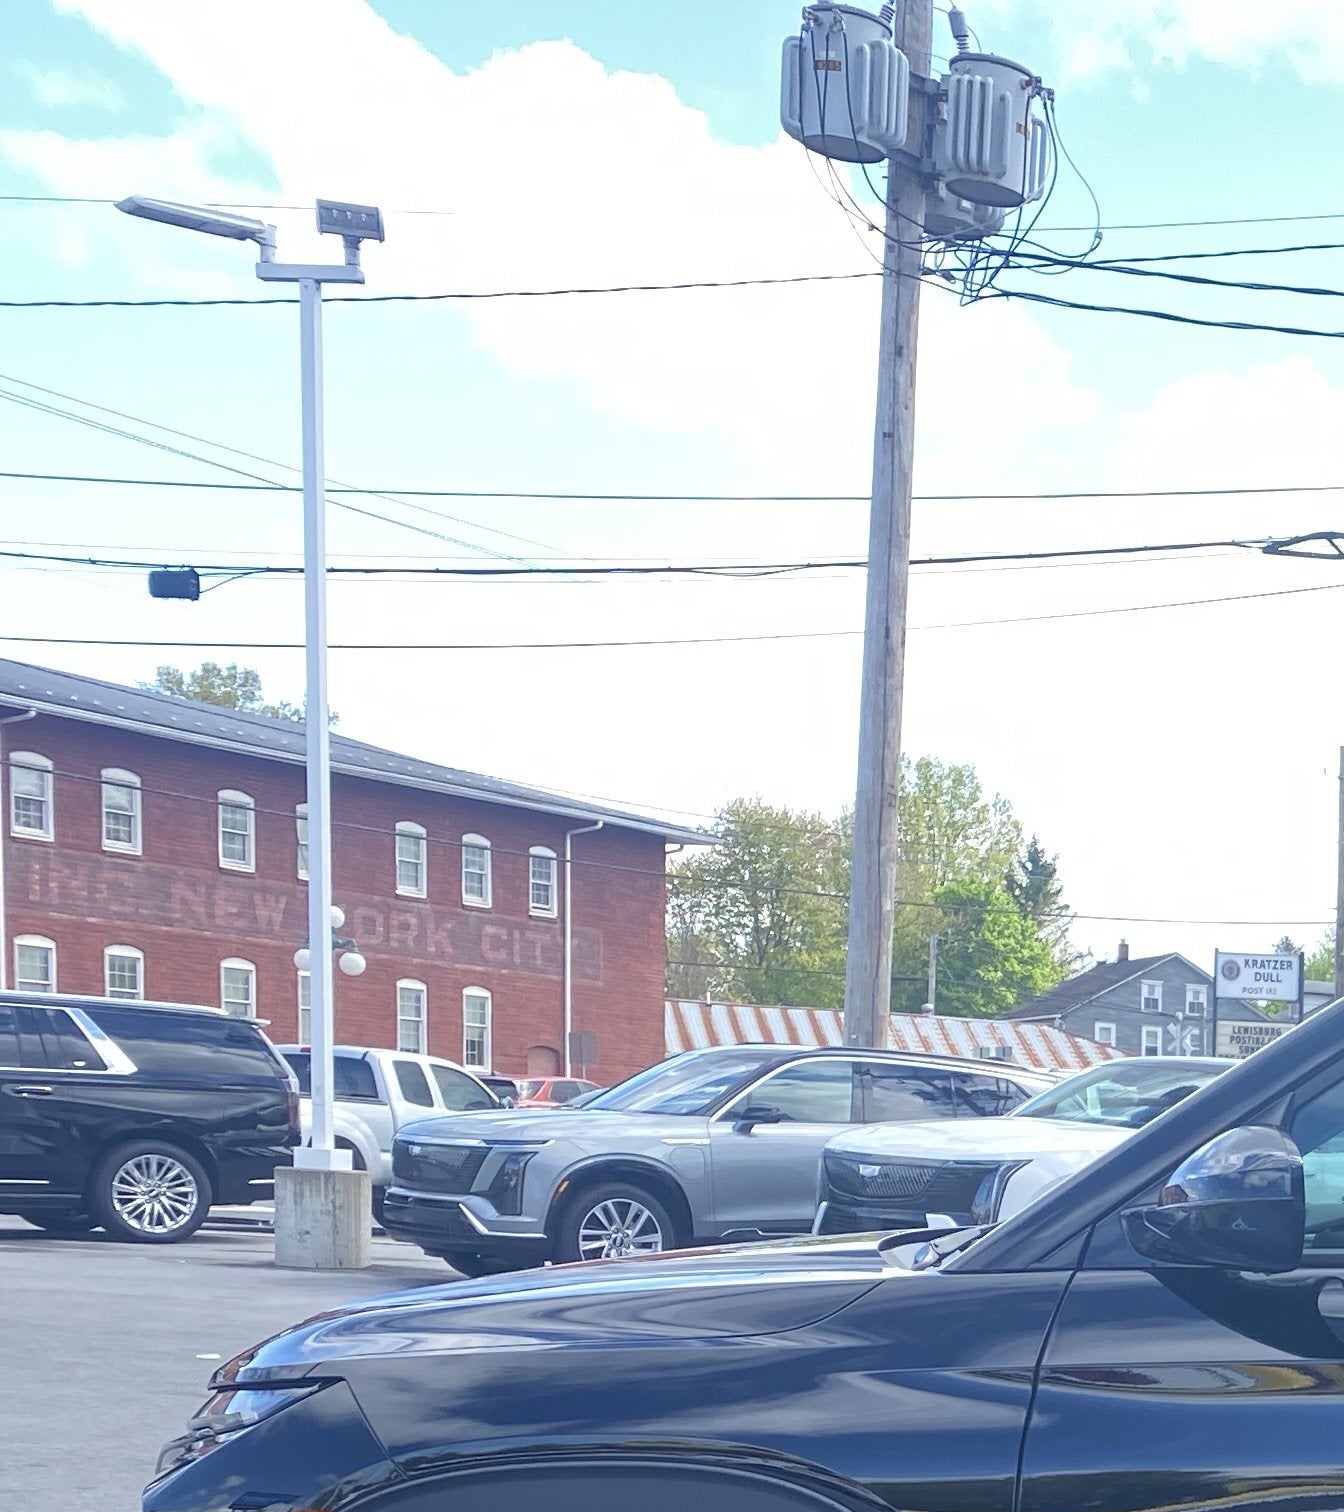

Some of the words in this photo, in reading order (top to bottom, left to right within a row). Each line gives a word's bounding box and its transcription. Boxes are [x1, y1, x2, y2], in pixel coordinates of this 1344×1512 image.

[170, 876, 288, 932] NEW
[1244, 958, 1293, 970] KRATZER
[1254, 972, 1282, 982] DULL
[1232, 1026, 1282, 1036] LEWISBURG
